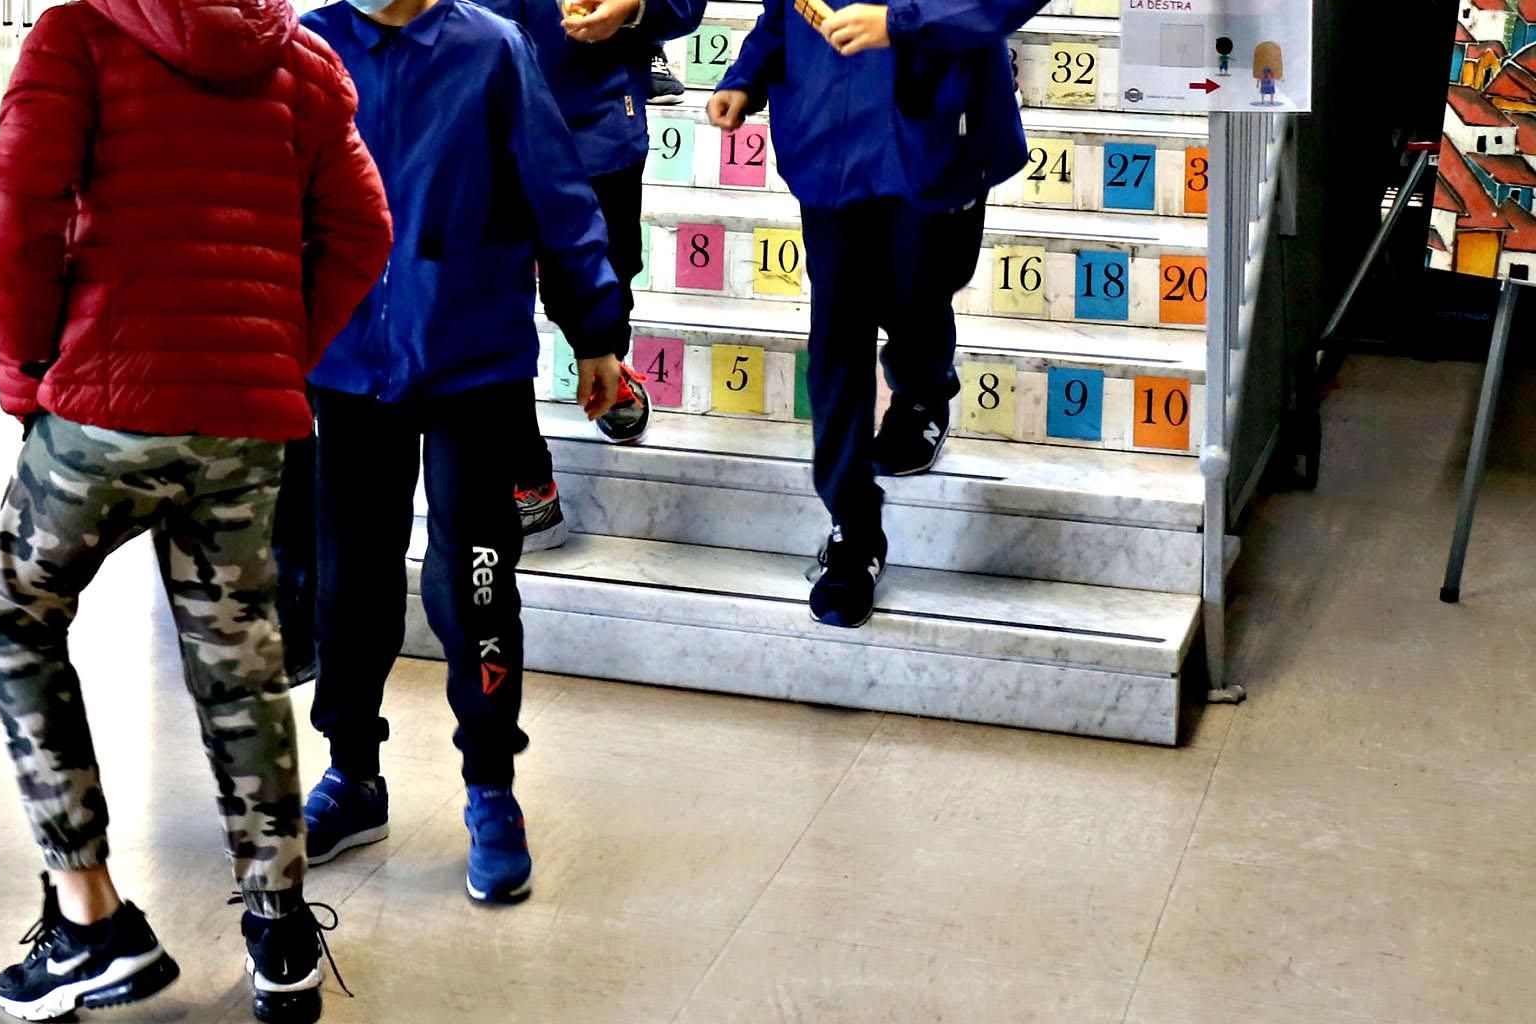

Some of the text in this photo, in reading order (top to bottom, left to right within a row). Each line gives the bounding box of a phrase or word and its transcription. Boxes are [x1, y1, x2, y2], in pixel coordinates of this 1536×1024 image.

[1129, 0, 1192, 11] LA DESTRA
[691, 33, 730, 65] 12
[1051, 51, 1096, 87] 32
[726, 133, 765, 167] 12
[1027, 147, 1072, 183] 24
[1107, 153, 1151, 188] 27
[1186, 157, 1208, 193] 3
[689, 233, 1208, 303] 8 10 16 18 20
[647, 348, 1189, 427] 4 5 8 9 10
